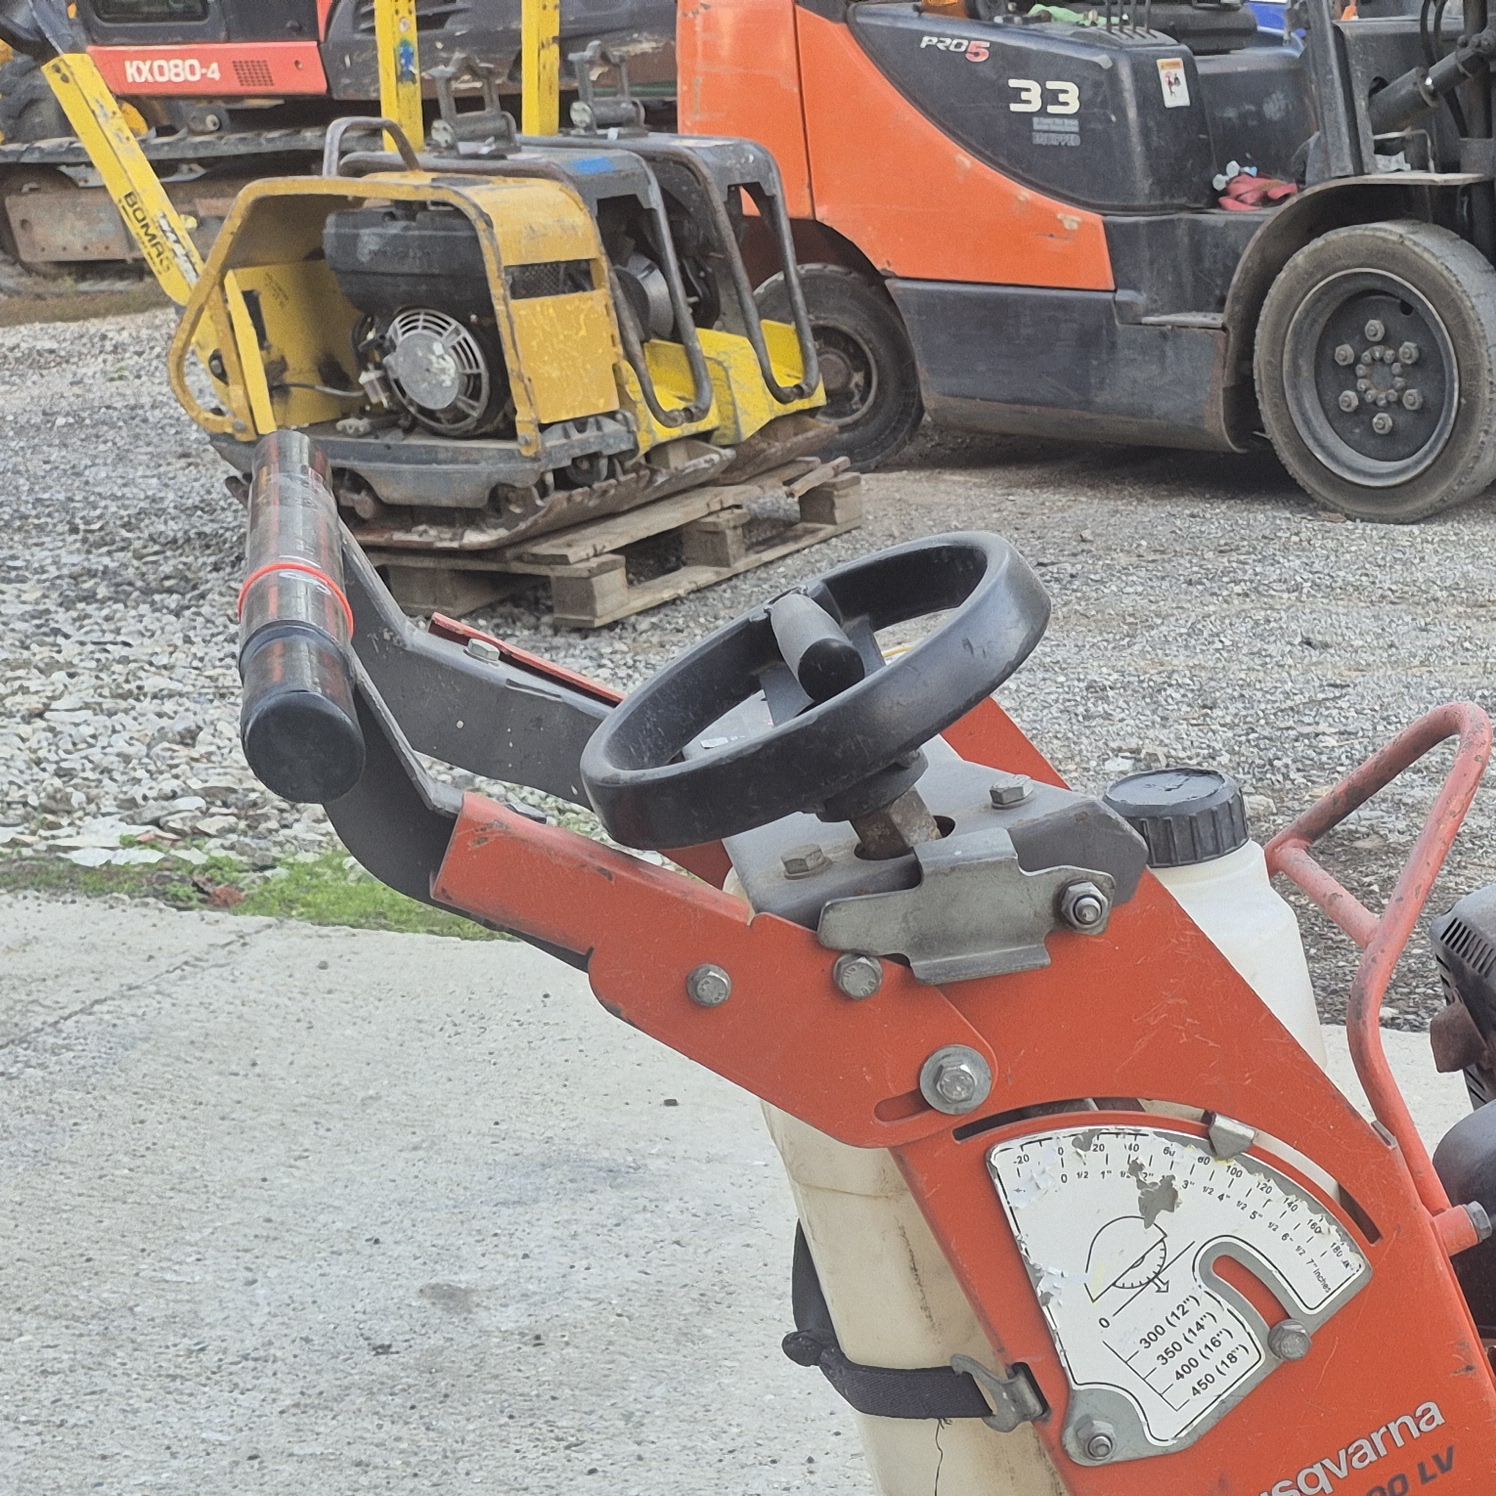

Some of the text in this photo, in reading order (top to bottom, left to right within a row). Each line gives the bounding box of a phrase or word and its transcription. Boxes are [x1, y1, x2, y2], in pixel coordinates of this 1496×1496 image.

[125, 59, 221, 83] KX080-4
[1008, 78, 1080, 115] 33
[1057, 1146, 1065, 1156] 0
[1092, 1143, 1105, 1152] 20
[1225, 1165, 1243, 1178] 100
[1255, 1181, 1273, 1194] 120
[1283, 1197, 1299, 1212] 140
[1306, 1218, 1321, 1234] 160
[1060, 1173, 1068, 1183] 0
[1312, 1268, 1332, 1294] inches
[1098, 1317, 1111, 1329] 0
[1139, 1295, 1200, 1349] 300 (12")
[1156, 1311, 1218, 1366] 350 (14")
[1174, 1327, 1234, 1381] 400 (16")
[1191, 1343, 1250, 1397] 450 (18")
[1417, 1445, 1456, 1487] LV
